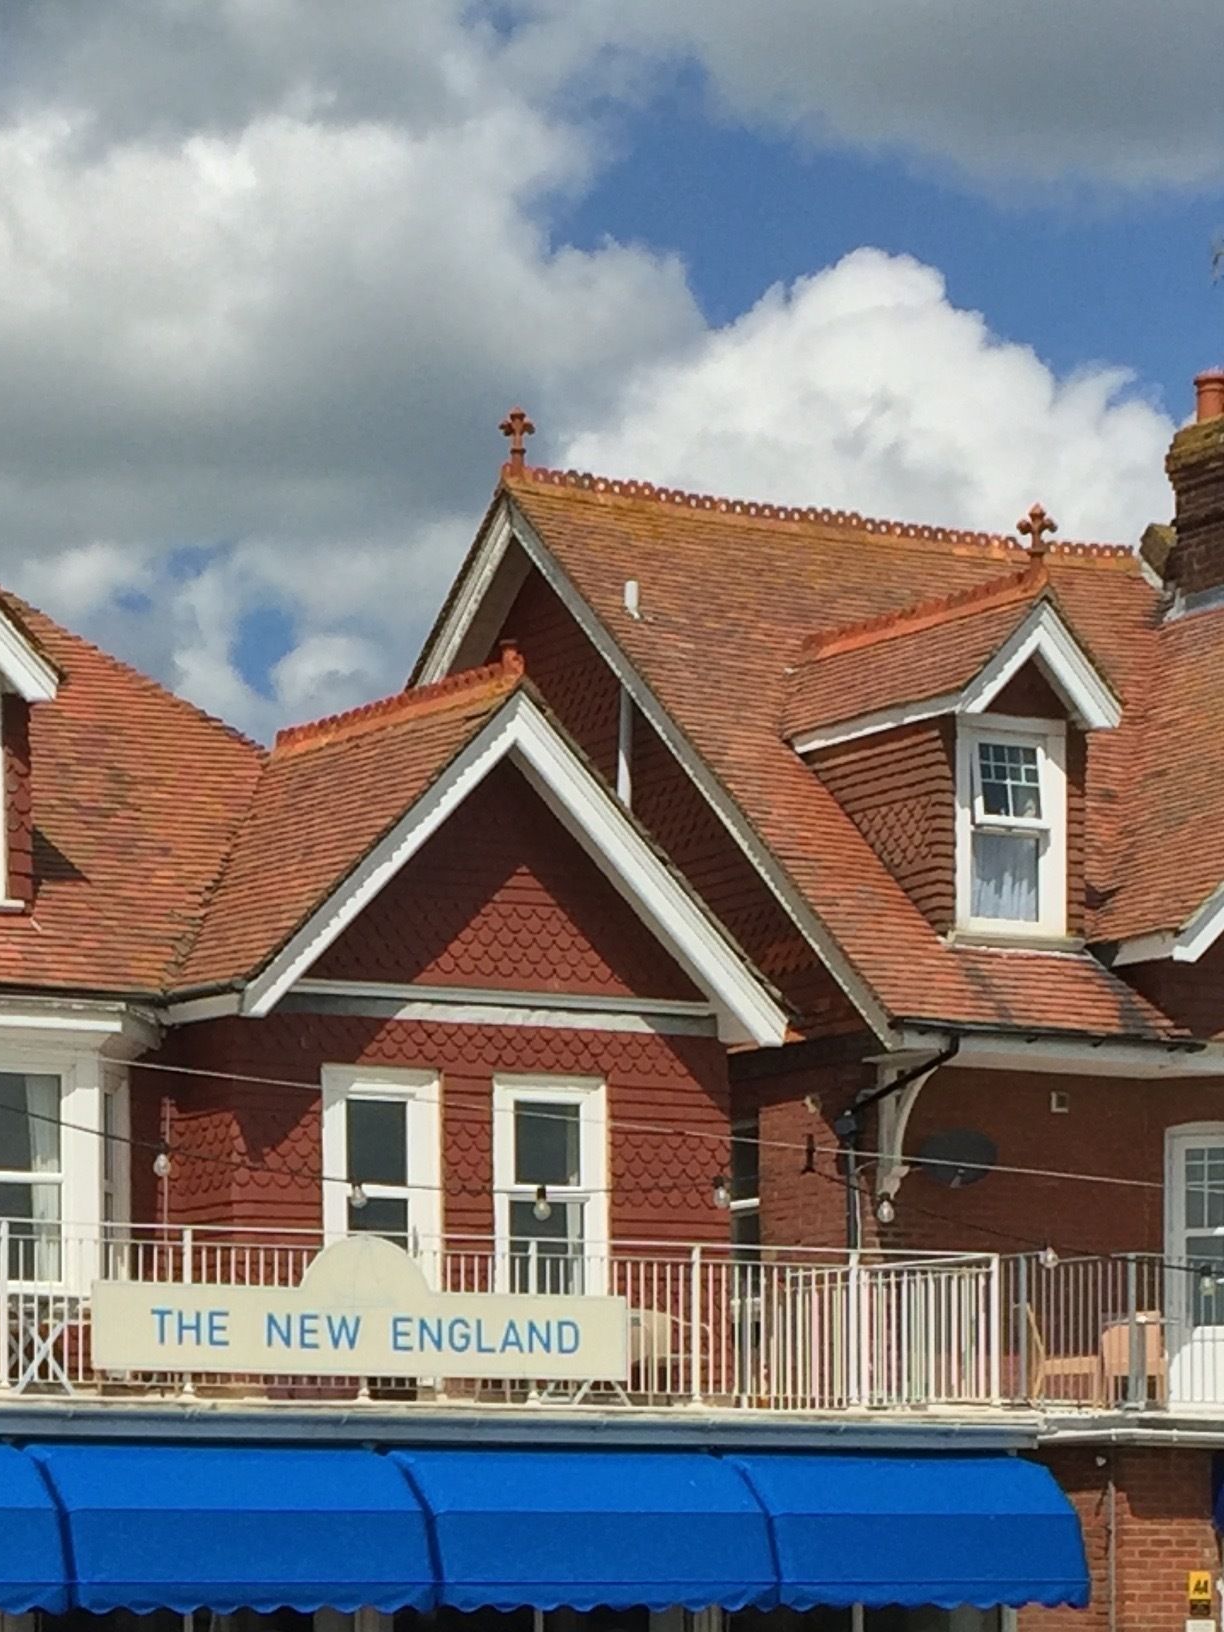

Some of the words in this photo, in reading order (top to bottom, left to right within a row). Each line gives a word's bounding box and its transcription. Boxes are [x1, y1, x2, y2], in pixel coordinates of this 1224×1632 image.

[151, 1308, 229, 1346] THE
[266, 1313, 361, 1350] NEW
[392, 1317, 580, 1354] ENGLAND
